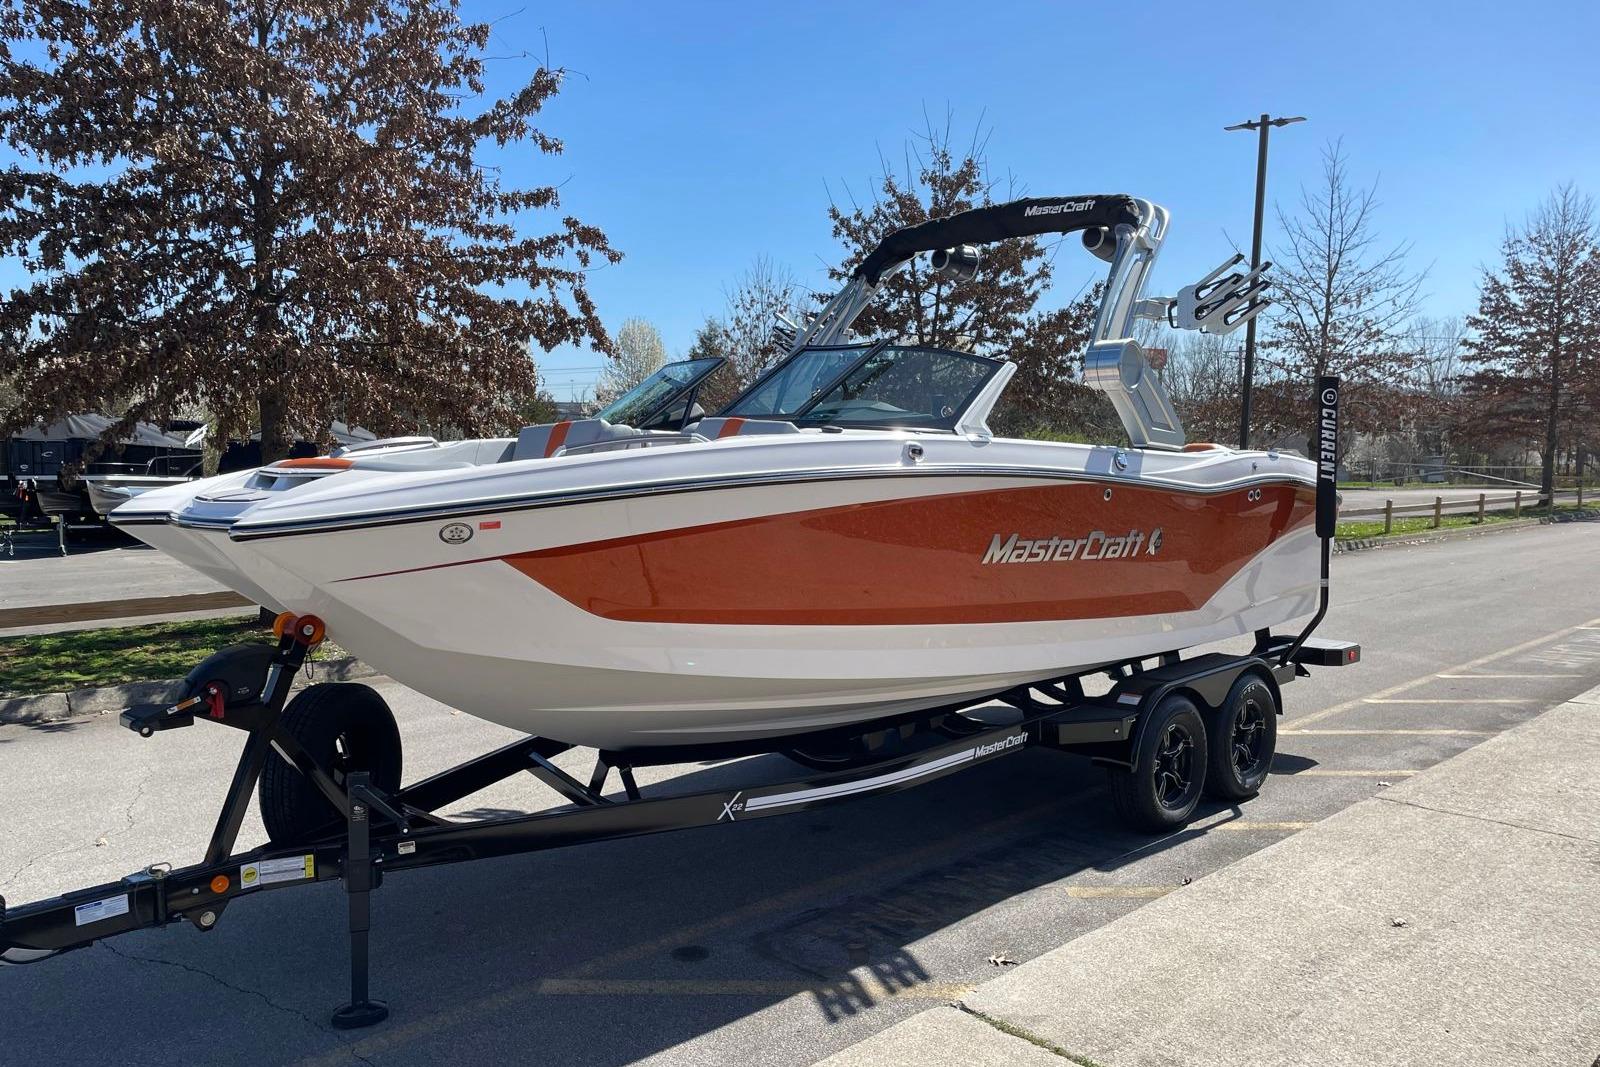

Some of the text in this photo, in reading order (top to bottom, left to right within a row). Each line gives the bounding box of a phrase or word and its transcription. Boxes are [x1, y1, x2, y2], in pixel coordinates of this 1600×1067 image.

[1024, 199, 1096, 217] MasterCraft
[1321, 408, 1337, 482] CURRENT
[981, 529, 1144, 565] MasterCraft
[975, 731, 1029, 758] MasterCraft
